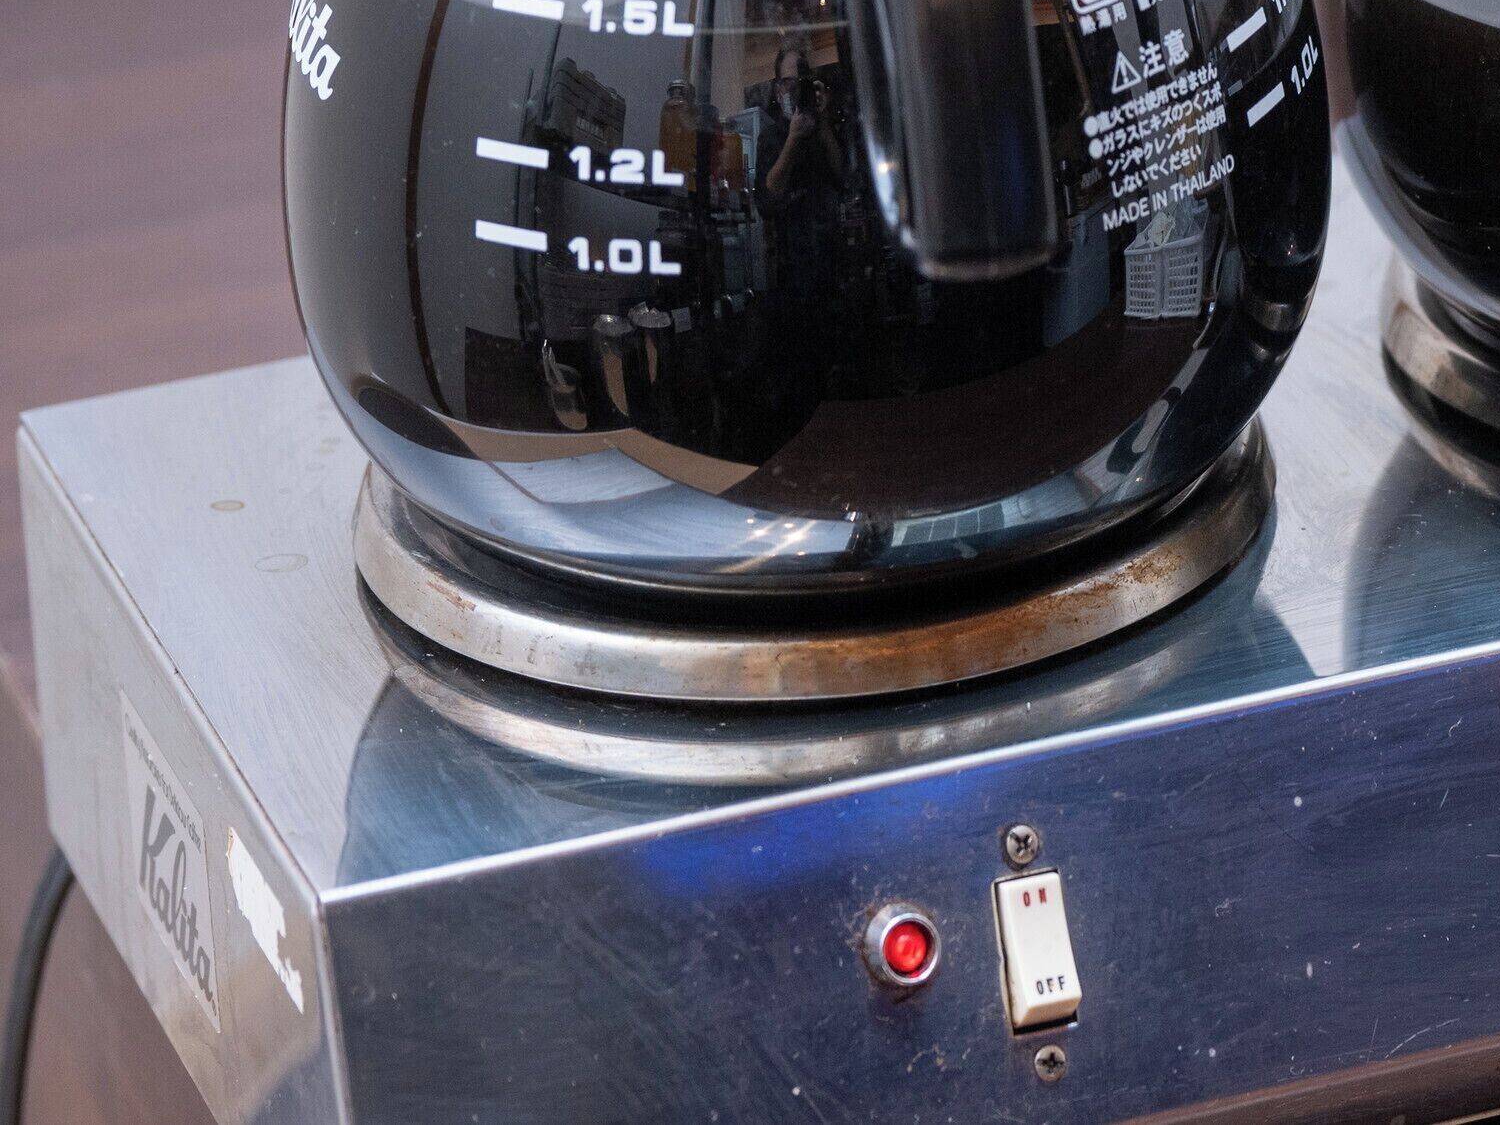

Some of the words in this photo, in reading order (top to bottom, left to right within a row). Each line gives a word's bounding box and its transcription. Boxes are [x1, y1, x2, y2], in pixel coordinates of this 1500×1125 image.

[1139, 28, 1189, 79] 注意
[1291, 35, 1319, 96] 1.0L
[568, 145, 685, 187] 1.2L
[1111, 144, 1202, 198] しないでください
[1102, 197, 1151, 232] MADE
[1152, 191, 1168, 212] IN
[1170, 154, 1236, 202] THAILAND
[567, 236, 682, 275] 1.0L
[139, 783, 214, 1002] Kalita
[1023, 888, 1047, 907] ON
[1036, 976, 1066, 995] OFF
